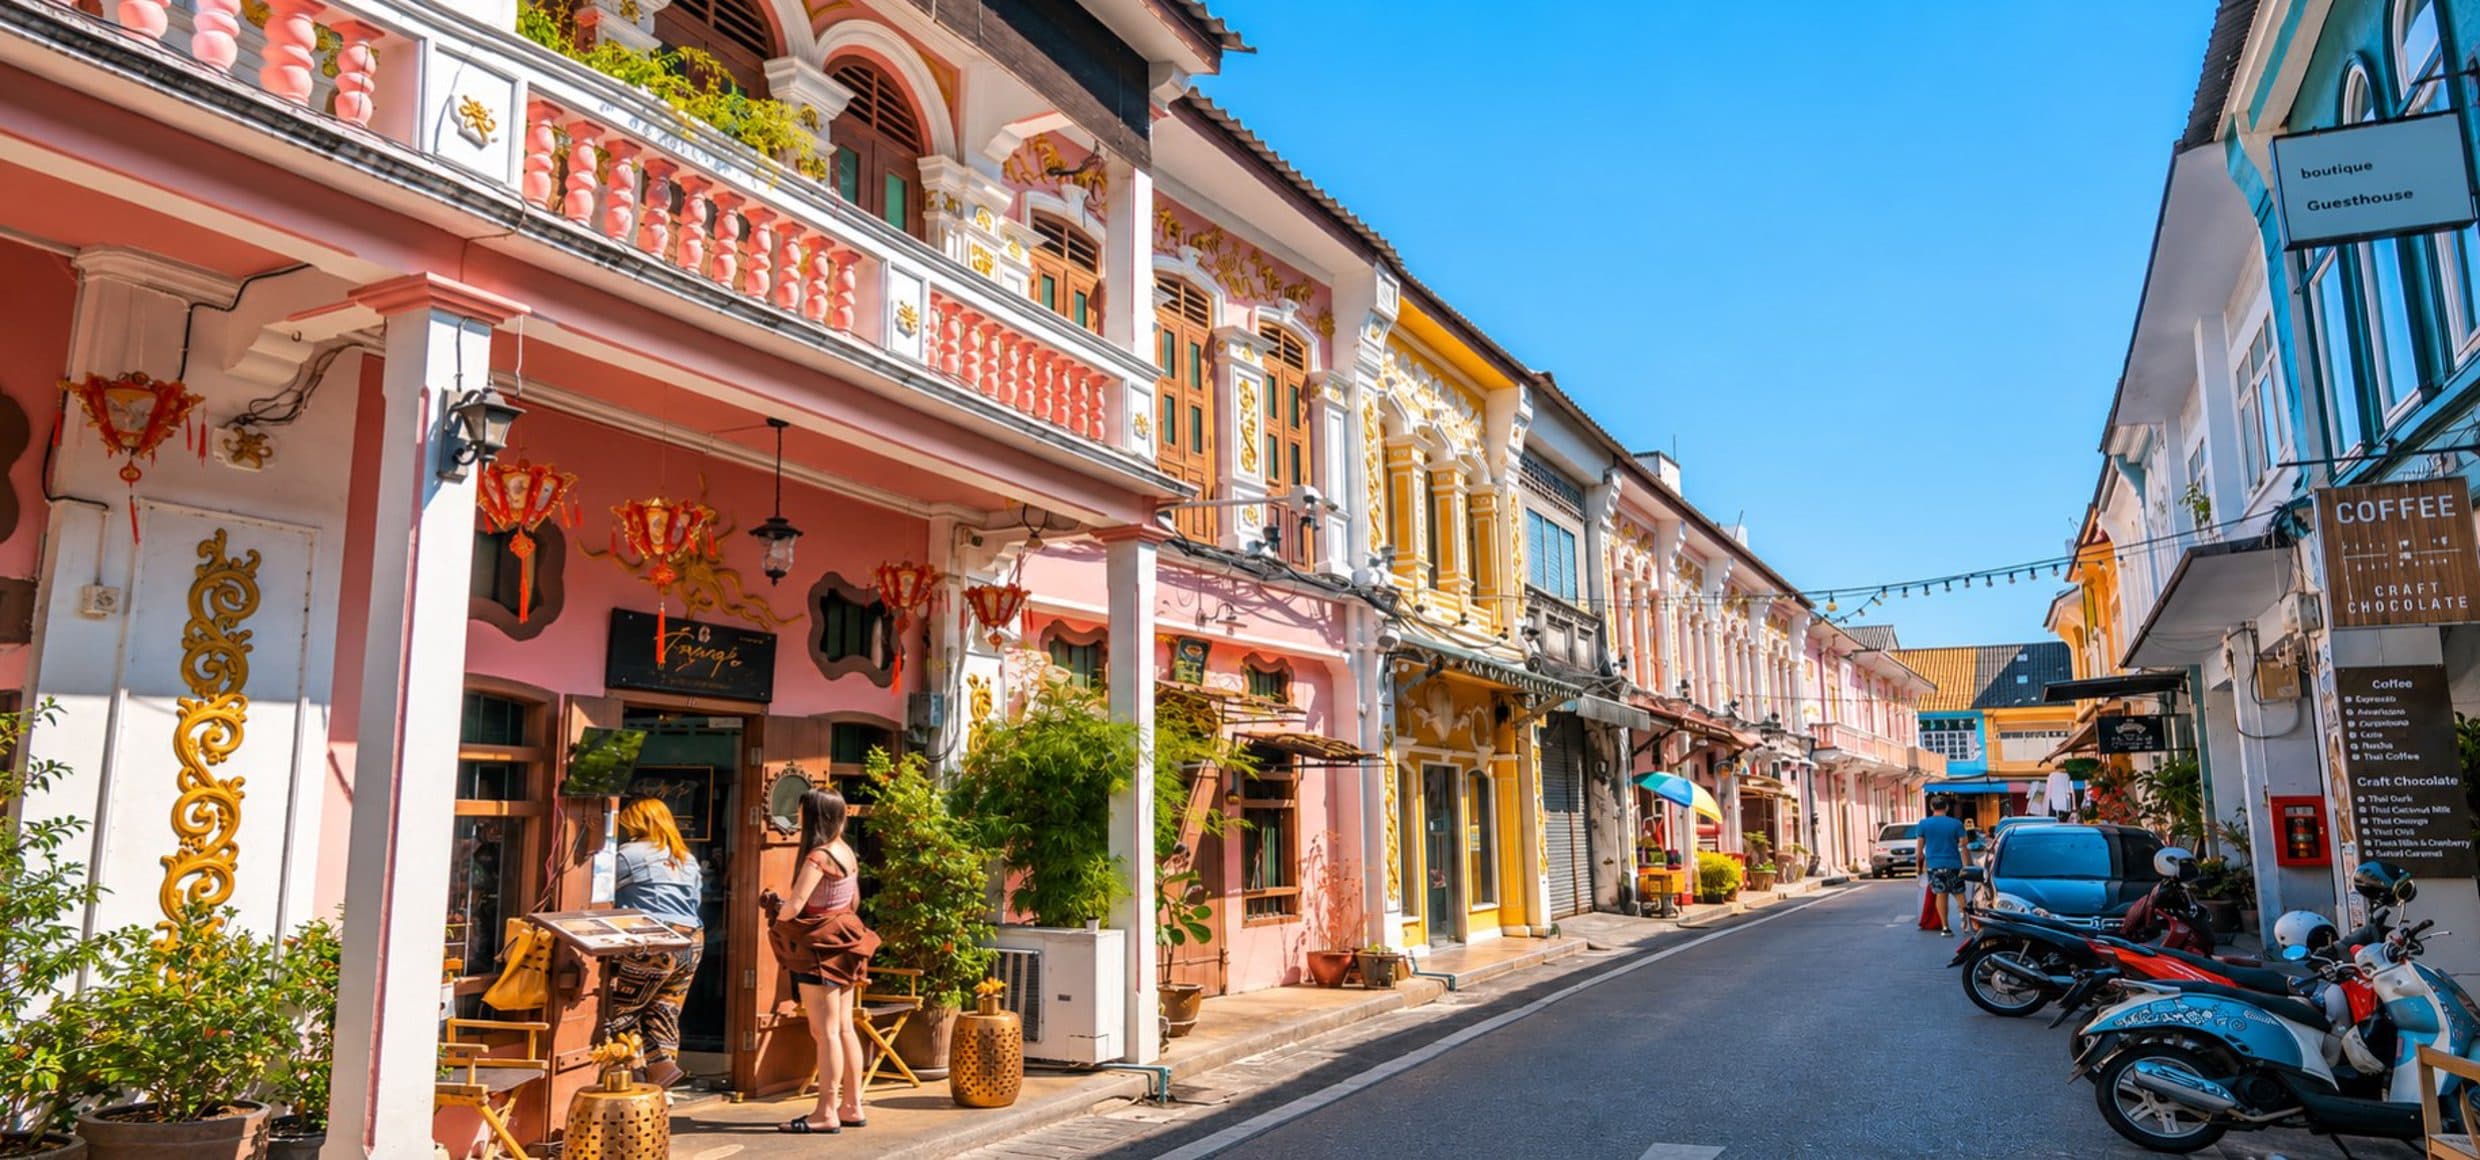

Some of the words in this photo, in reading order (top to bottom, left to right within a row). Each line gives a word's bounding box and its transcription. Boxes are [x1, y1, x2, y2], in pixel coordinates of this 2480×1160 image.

[2301, 161, 2373, 180] boutique
[2307, 189, 2414, 212] Guesthouse
[2336, 494, 2457, 524] COFFEE
[2374, 581, 2439, 598] CRAFT
[2347, 595, 2469, 615] CHOCOLATE
[2372, 679, 2413, 689] Coffee
[2357, 776, 2391, 787] Craft
[2394, 775, 2459, 786] Chocolate
